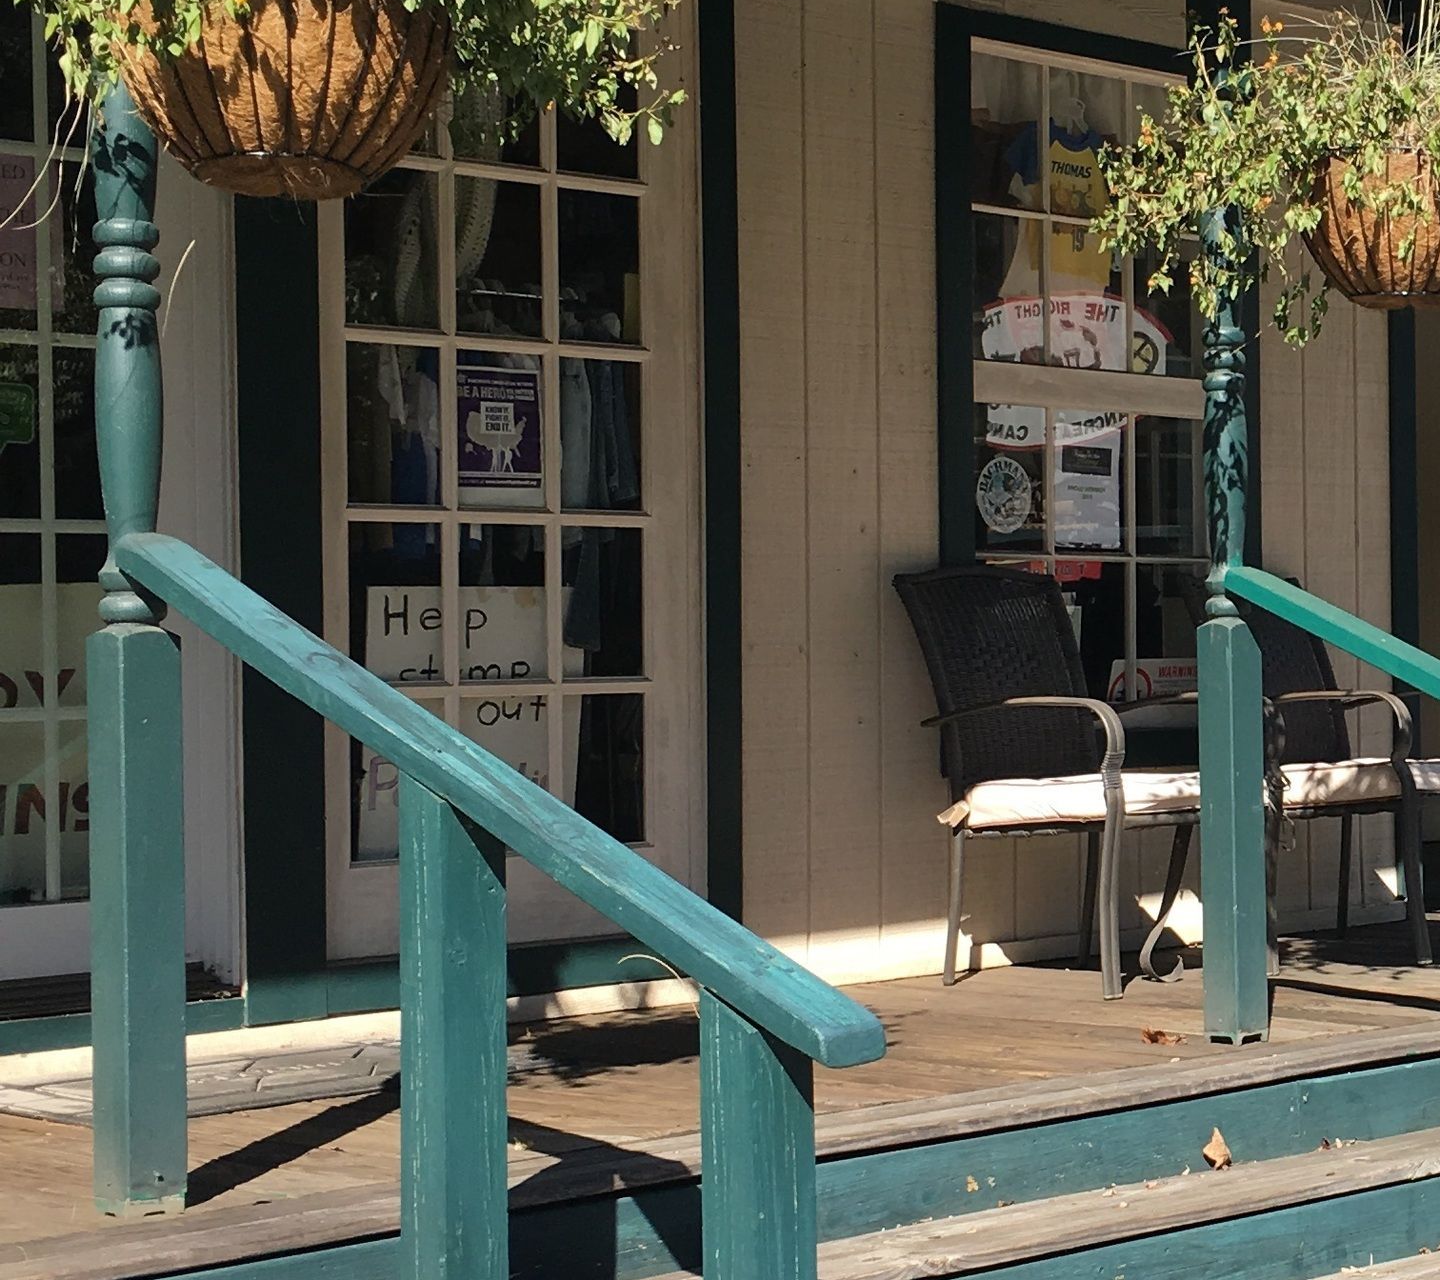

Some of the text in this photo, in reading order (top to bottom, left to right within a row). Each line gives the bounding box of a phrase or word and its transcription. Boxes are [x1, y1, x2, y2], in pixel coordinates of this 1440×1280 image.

[1051, 161, 1092, 178] THOMAS
[384, 594, 488, 649] Hep
[1158, 665, 1197, 679] WARNIN
[477, 695, 547, 726] out
